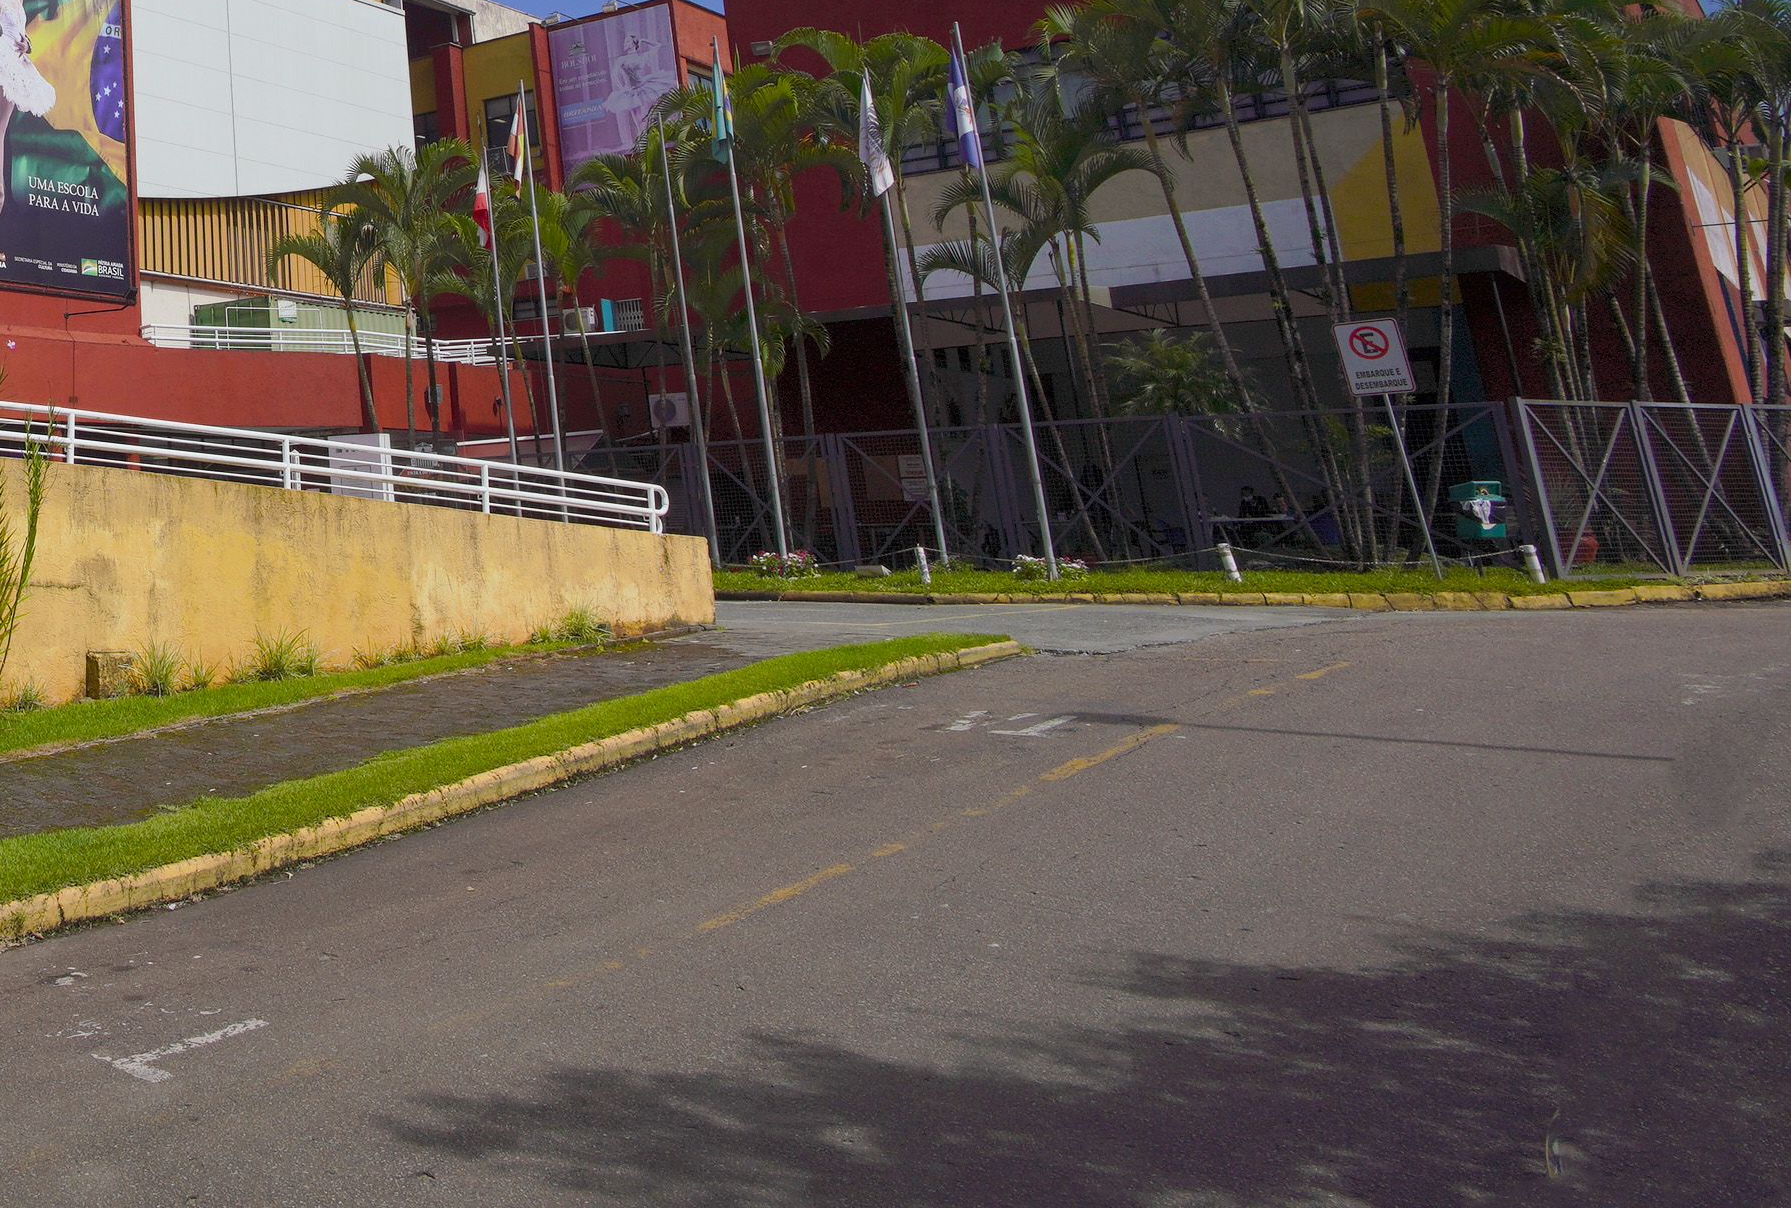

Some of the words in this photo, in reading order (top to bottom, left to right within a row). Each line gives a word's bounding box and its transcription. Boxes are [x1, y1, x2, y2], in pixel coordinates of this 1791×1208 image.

[561, 54, 597, 70] BOLSHOI
[28, 175, 56, 192] UMA
[56, 181, 99, 200] ESCOLA
[29, 193, 59, 210] PARA
[61, 199, 70, 212] A
[72, 201, 100, 217] VIDA
[98, 265, 125, 277] BRASIL
[1355, 368, 1395, 379] EMBARQUE
[1395, 367, 1402, 376] E
[1355, 378, 1408, 390] DESEMBARQUE
